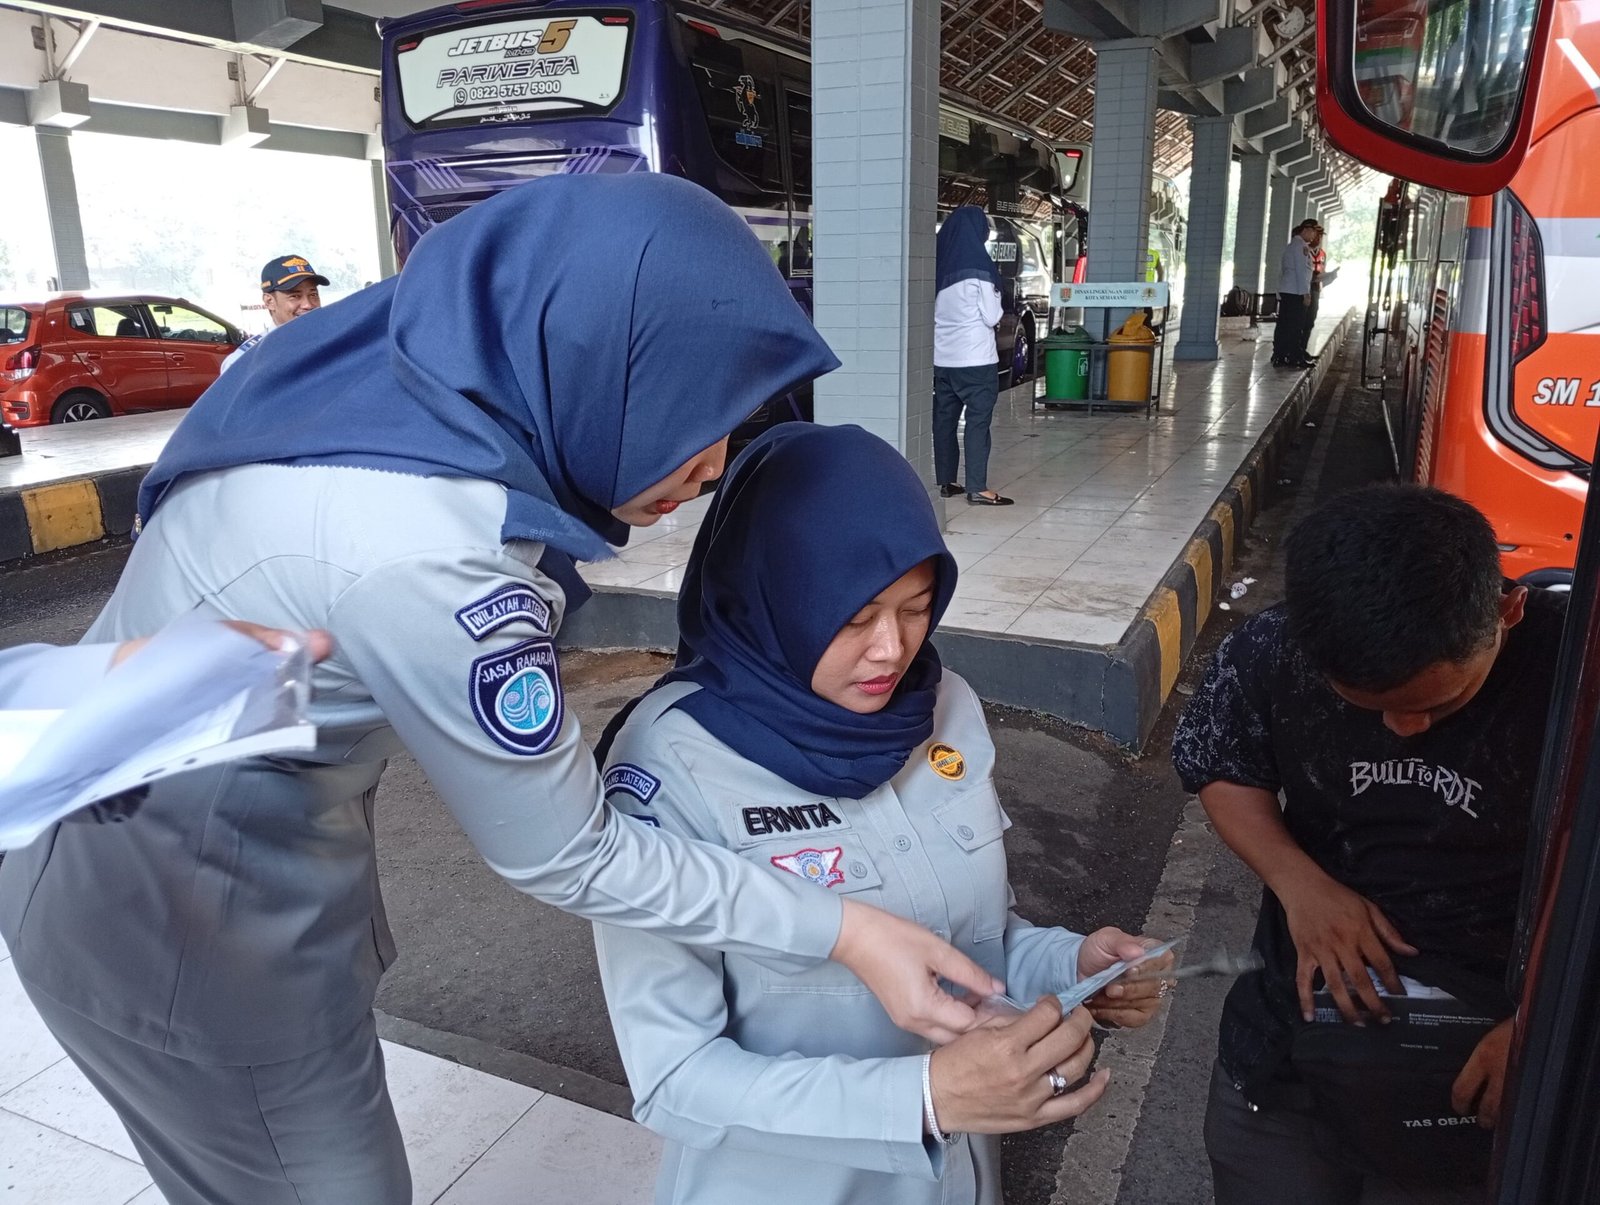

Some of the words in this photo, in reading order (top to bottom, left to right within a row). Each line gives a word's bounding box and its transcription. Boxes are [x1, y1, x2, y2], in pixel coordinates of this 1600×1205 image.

[448, 29, 543, 57] JETBUS
[537, 19, 578, 54] 5
[437, 55, 579, 88] PARIWISATA
[470, 86, 498, 100] 0822
[500, 83, 528, 97] 5757
[530, 80, 562, 95] 5900
[1532, 377, 1582, 406] SM
[470, 596, 519, 628] WILAYAH
[521, 597, 547, 623] JATENG
[482, 661, 515, 683] JASA
[516, 651, 553, 671] RAHARJA
[620, 772, 651, 793] JATENG
[1349, 757, 1424, 797] BUILT
[1416, 764, 1433, 788] TO
[741, 802, 843, 836] ERNITA
[1402, 1119, 1432, 1128] TAS
[1437, 1115, 1477, 1126] OBAT
